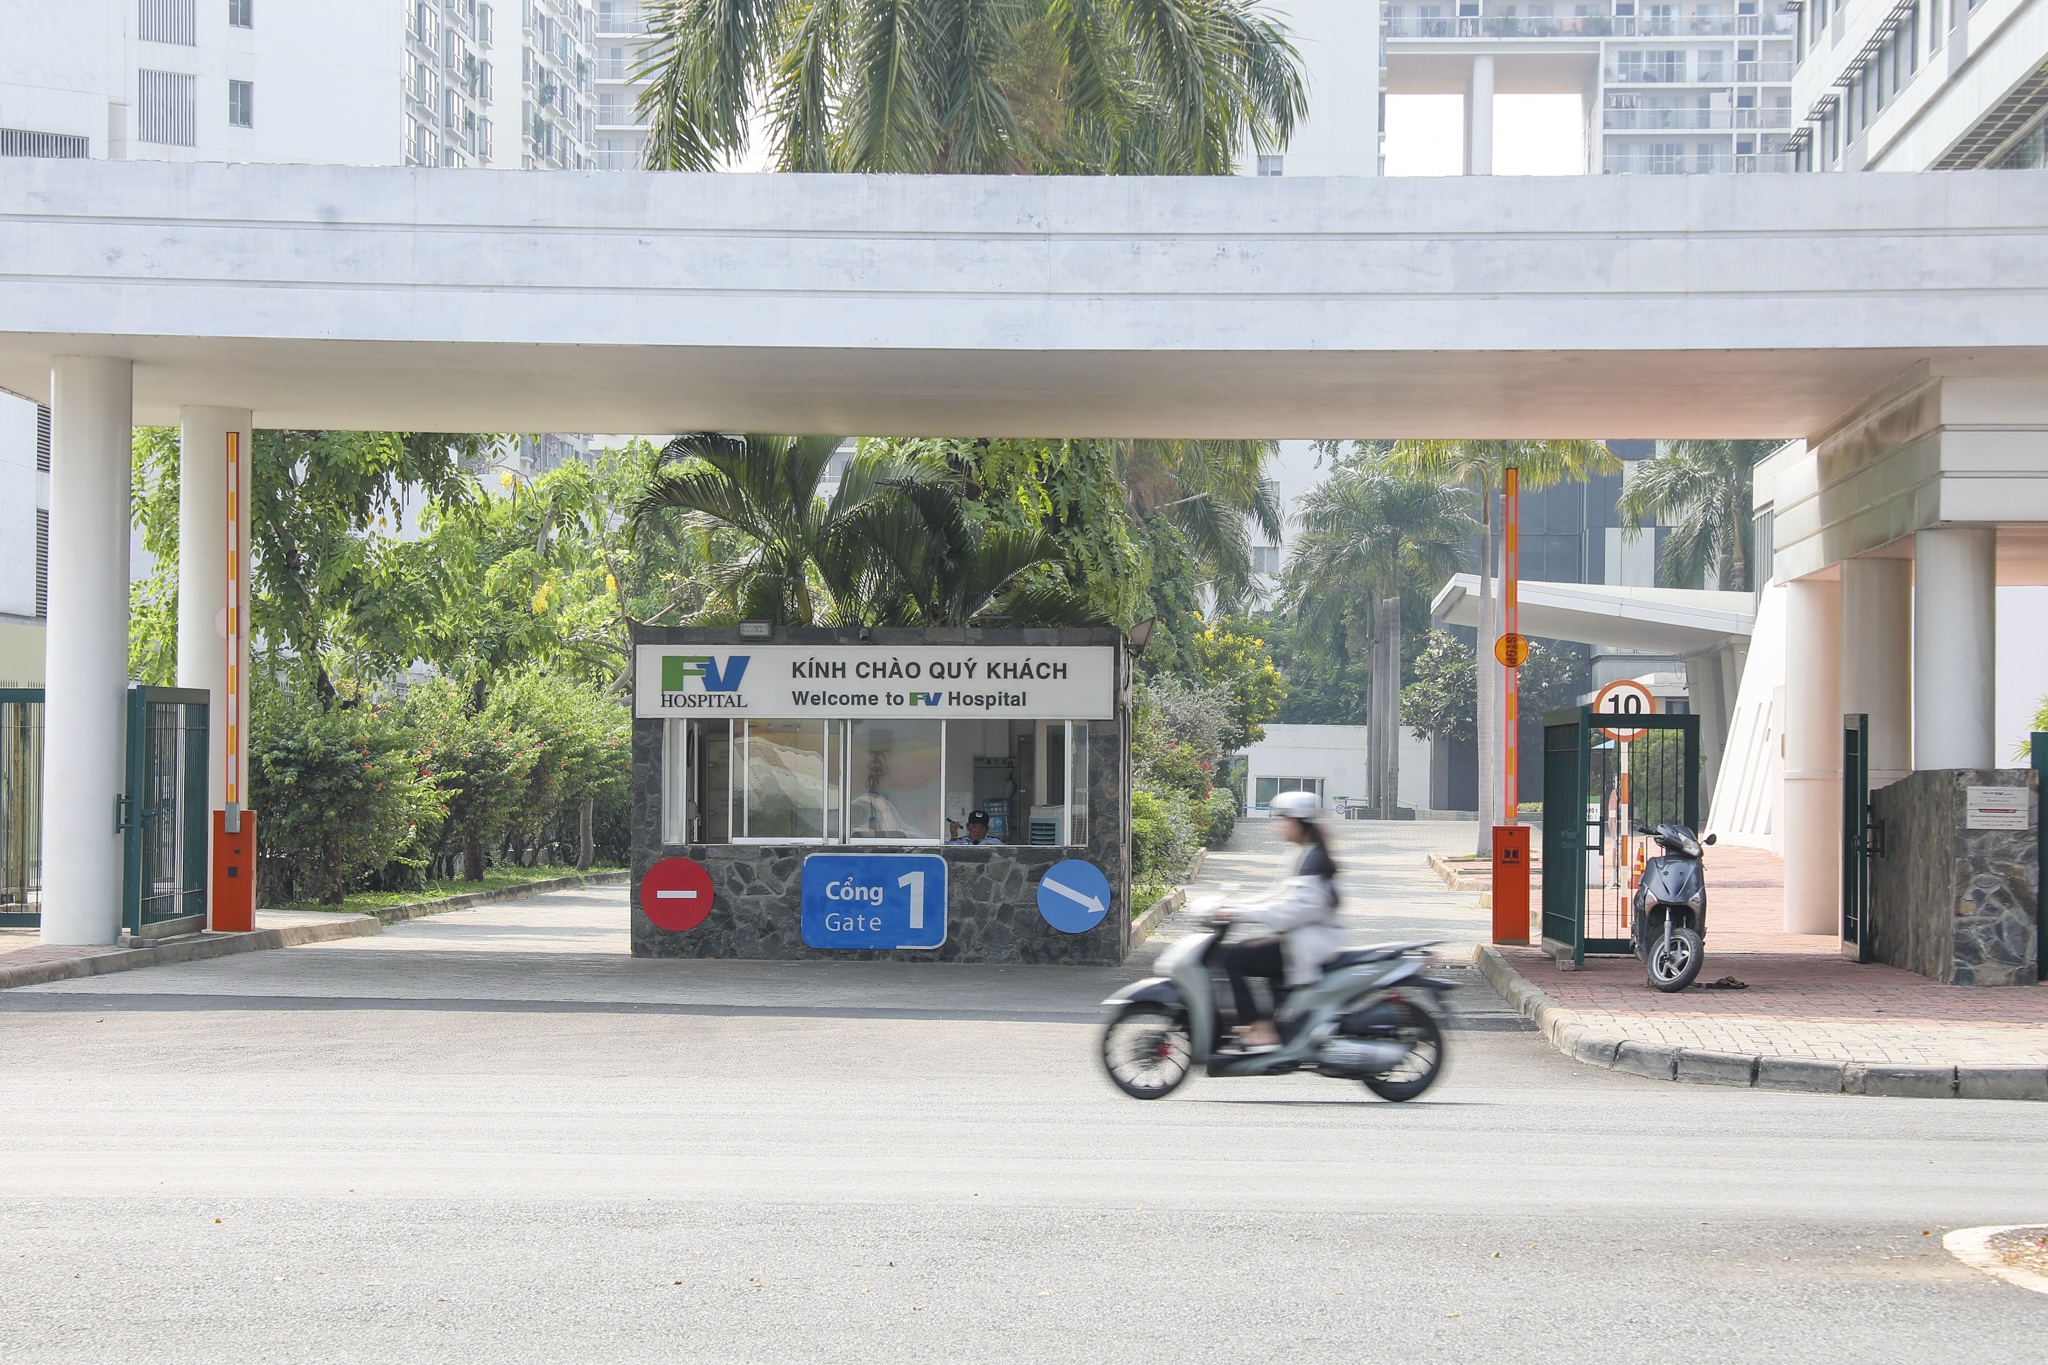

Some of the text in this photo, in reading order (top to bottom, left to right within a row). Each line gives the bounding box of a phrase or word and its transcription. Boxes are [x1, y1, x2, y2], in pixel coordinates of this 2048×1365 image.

[1505, 636, 1518, 665] STOP
[661, 655, 751, 692] FV
[792, 657, 1068, 680] KÍNH CHÀO QUÝ KHÁCH
[660, 693, 748, 708] HOSPITAL
[792, 690, 1028, 710] Welcome to FV Hospital
[1608, 694, 1642, 715] 10
[825, 871, 925, 929] Cổng 1
[825, 912, 883, 932] Gate
